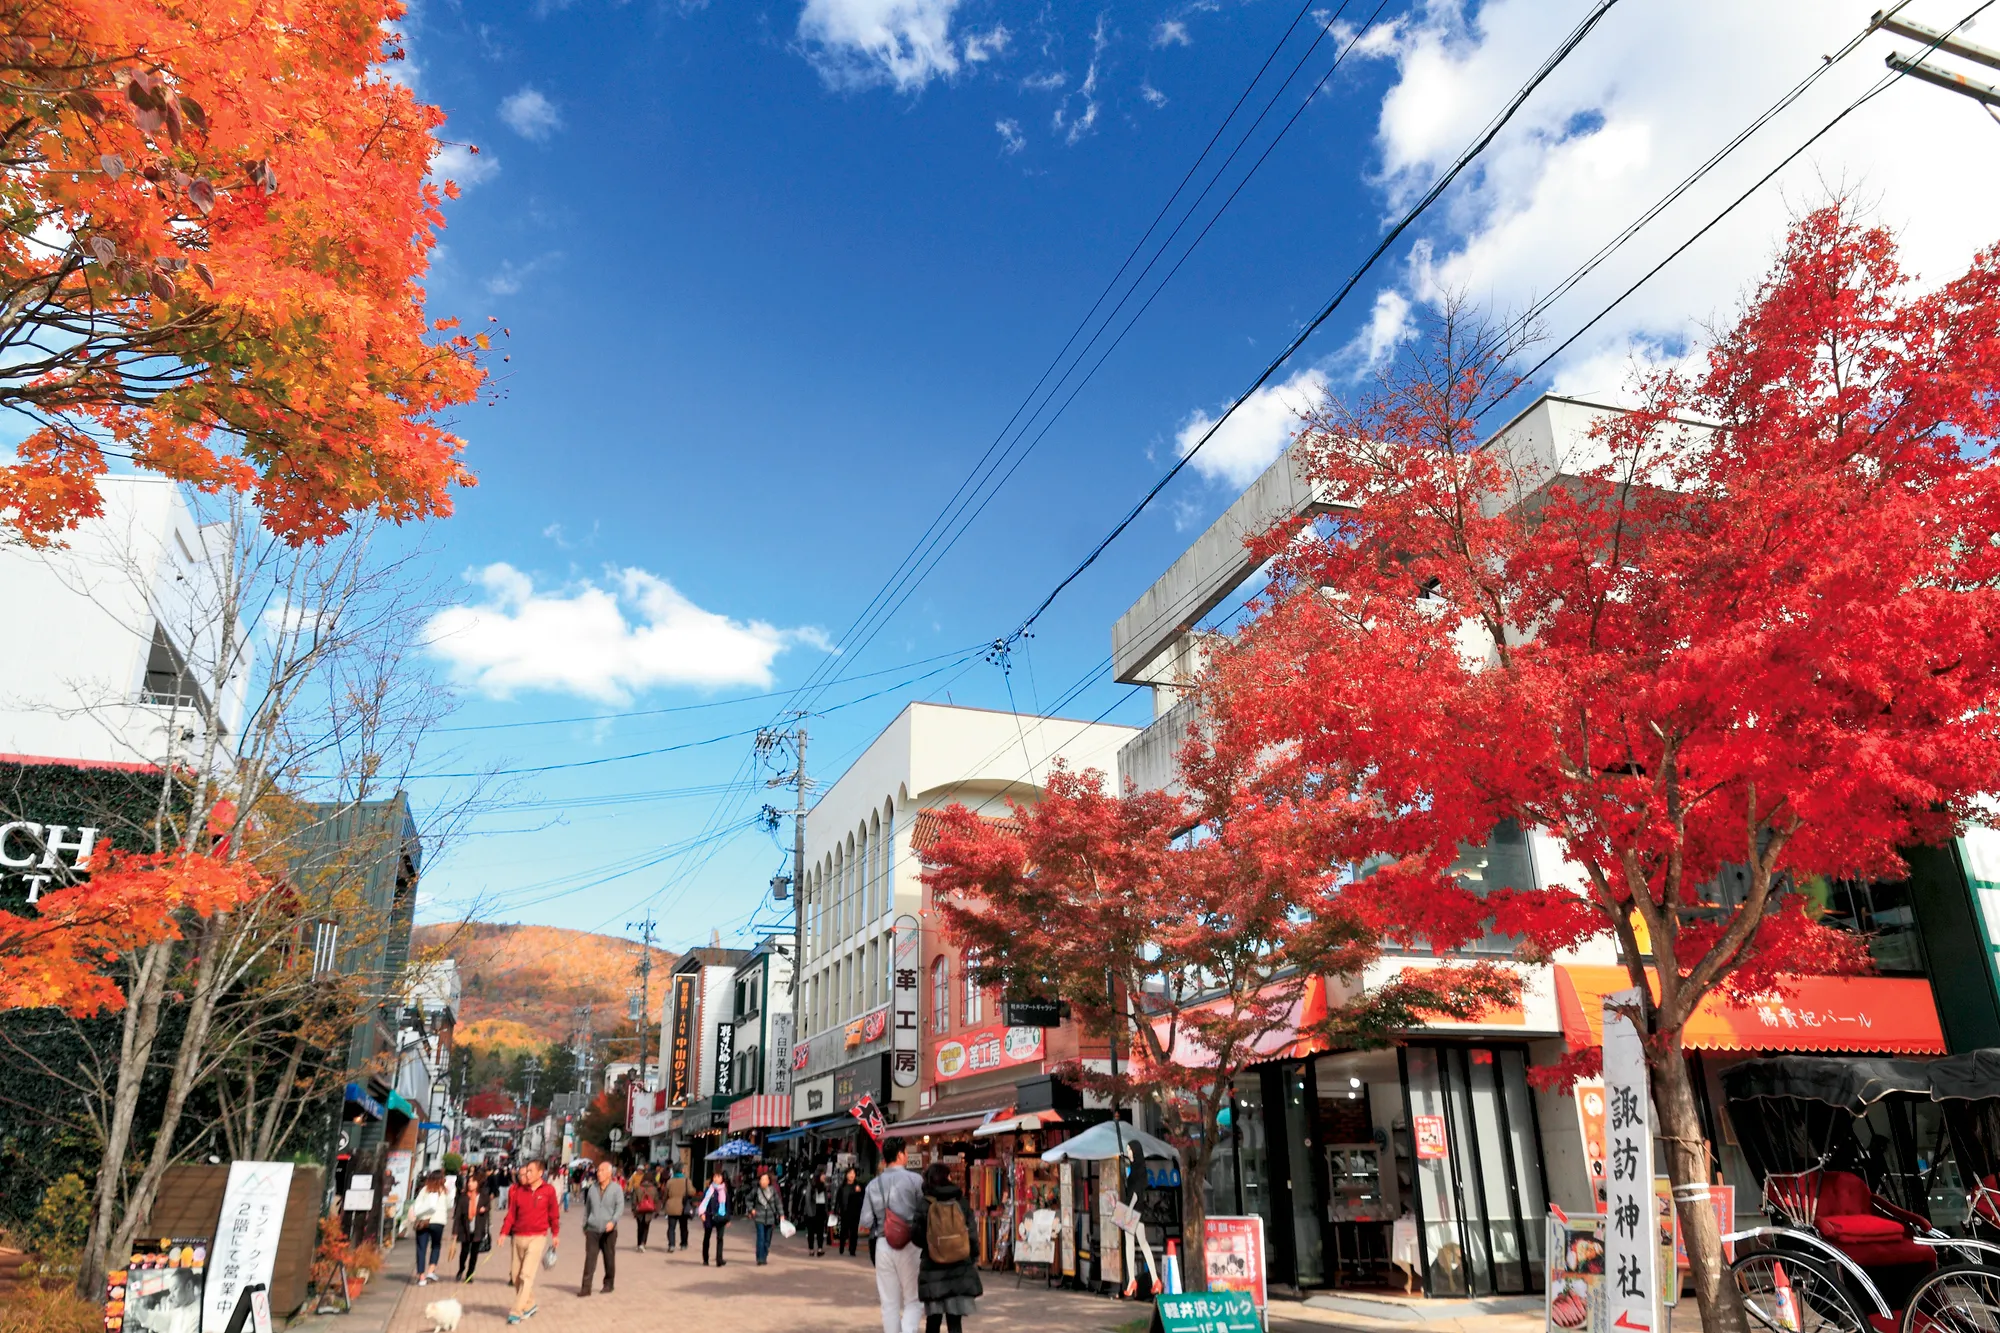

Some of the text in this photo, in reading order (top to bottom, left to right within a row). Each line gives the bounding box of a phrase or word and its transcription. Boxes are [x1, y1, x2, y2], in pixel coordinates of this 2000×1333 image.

[896, 969, 917, 1073] 革工房
[1757, 1006, 1872, 1029] 楊貴妃パール
[969, 1038, 1000, 1071] 革工房
[1611, 1085, 1645, 1299] 諏訪神社
[216, 1202, 251, 1315] 2階にて営業中
[1163, 1300, 1252, 1319] 軽井沢シルク
